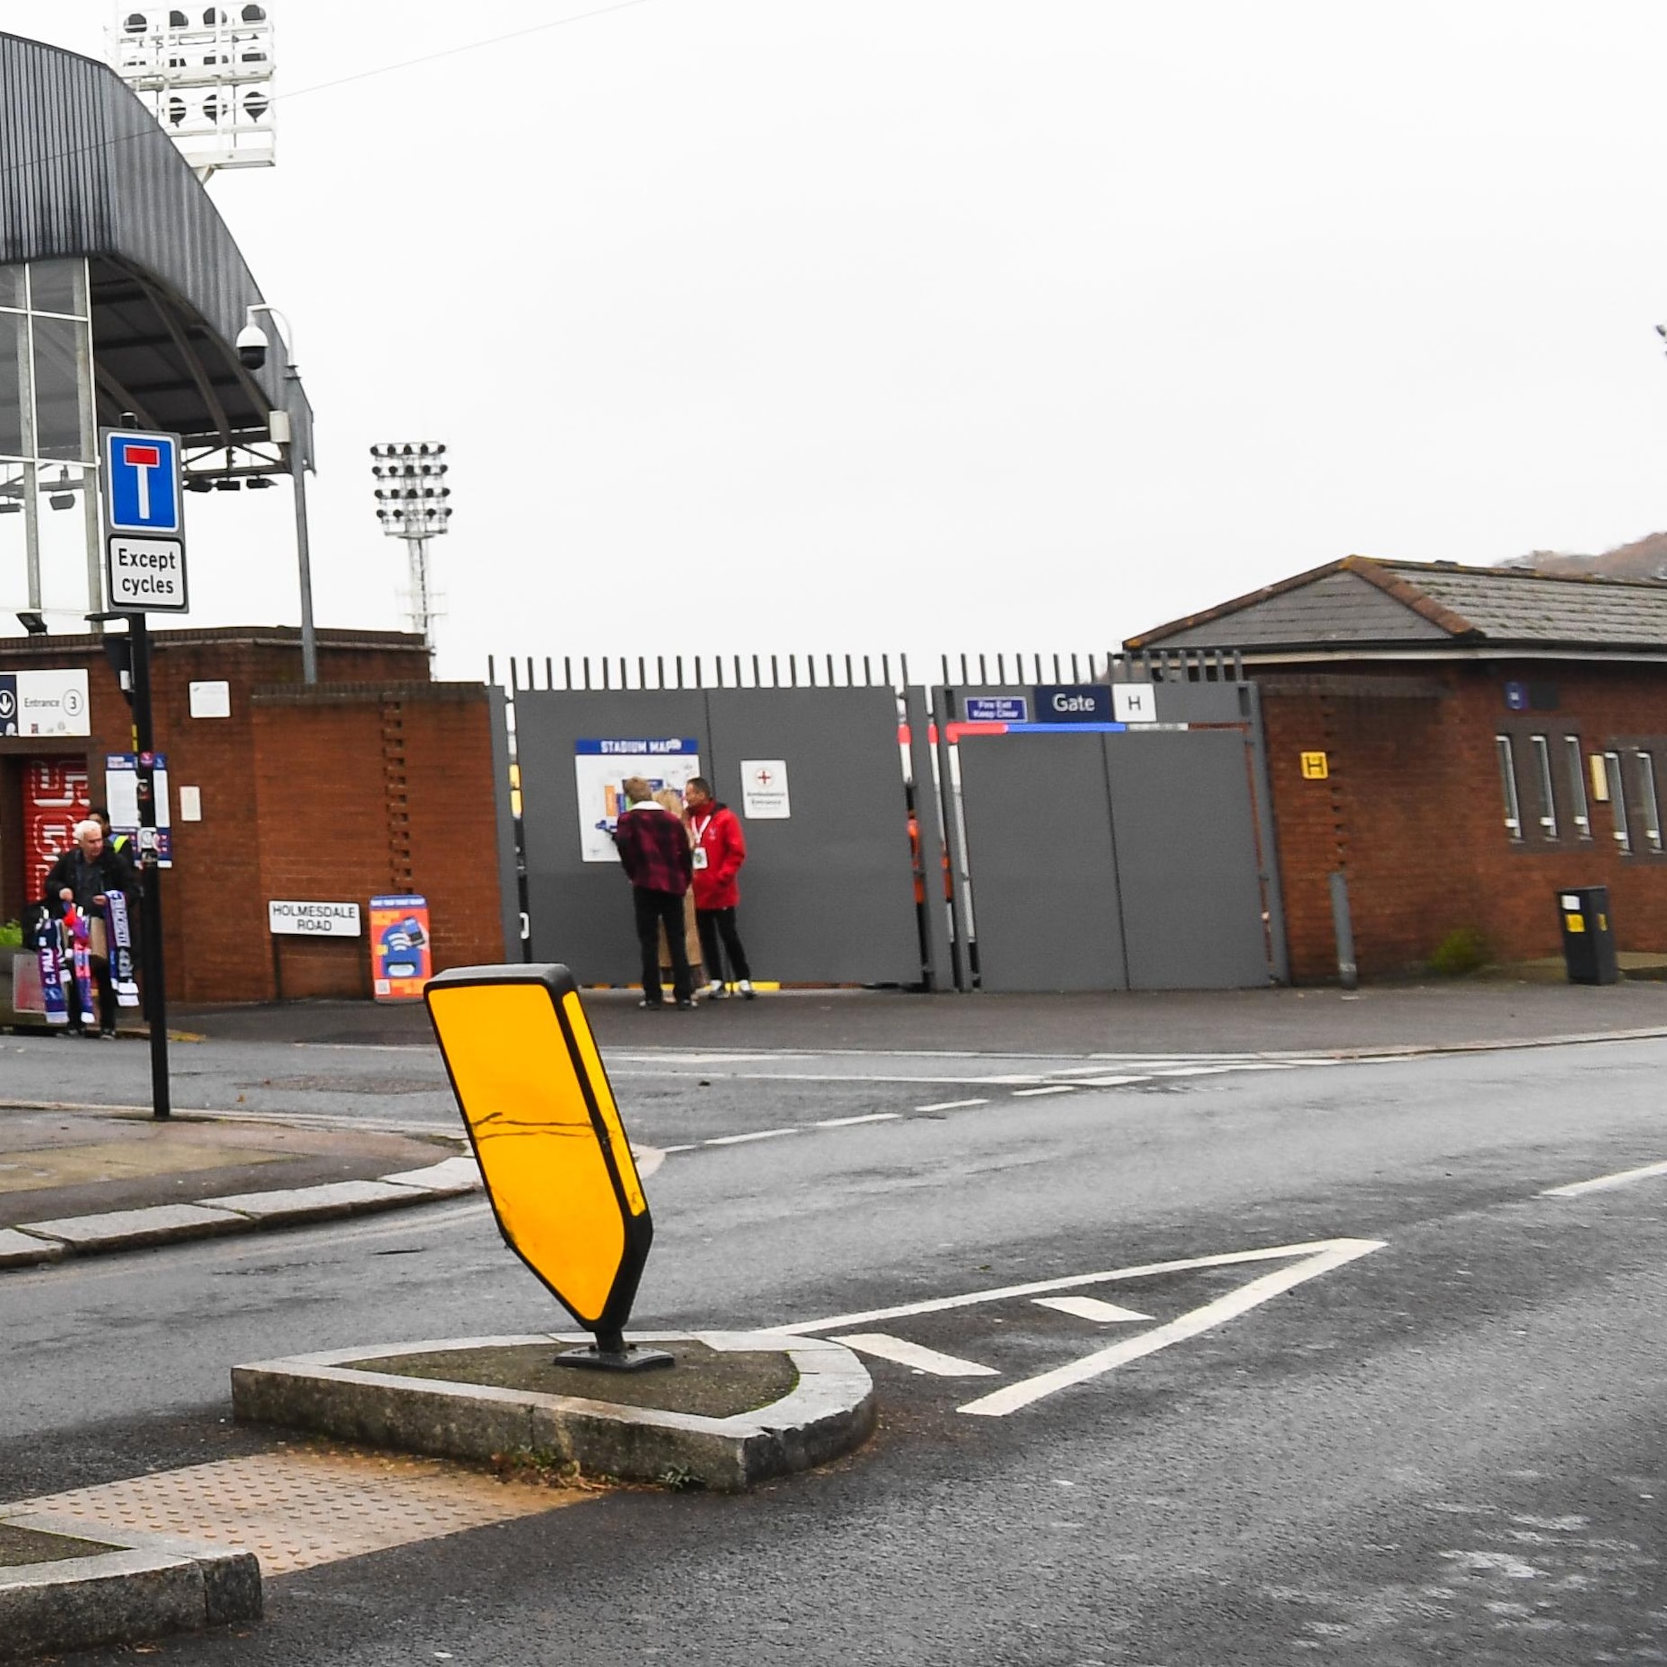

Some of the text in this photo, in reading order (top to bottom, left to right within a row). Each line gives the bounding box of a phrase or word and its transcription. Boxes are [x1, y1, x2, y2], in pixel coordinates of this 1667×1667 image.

[118, 548, 176, 572] Except
[122, 574, 174, 596] cycles
[24, 696, 77, 710] Entrance 3
[1052, 692, 1142, 712] Gate H
[601, 740, 647, 753] STADIUM
[1305, 755, 1325, 776] H
[272, 905, 356, 919] HOLMESDALE
[297, 919, 332, 932] ROAD
